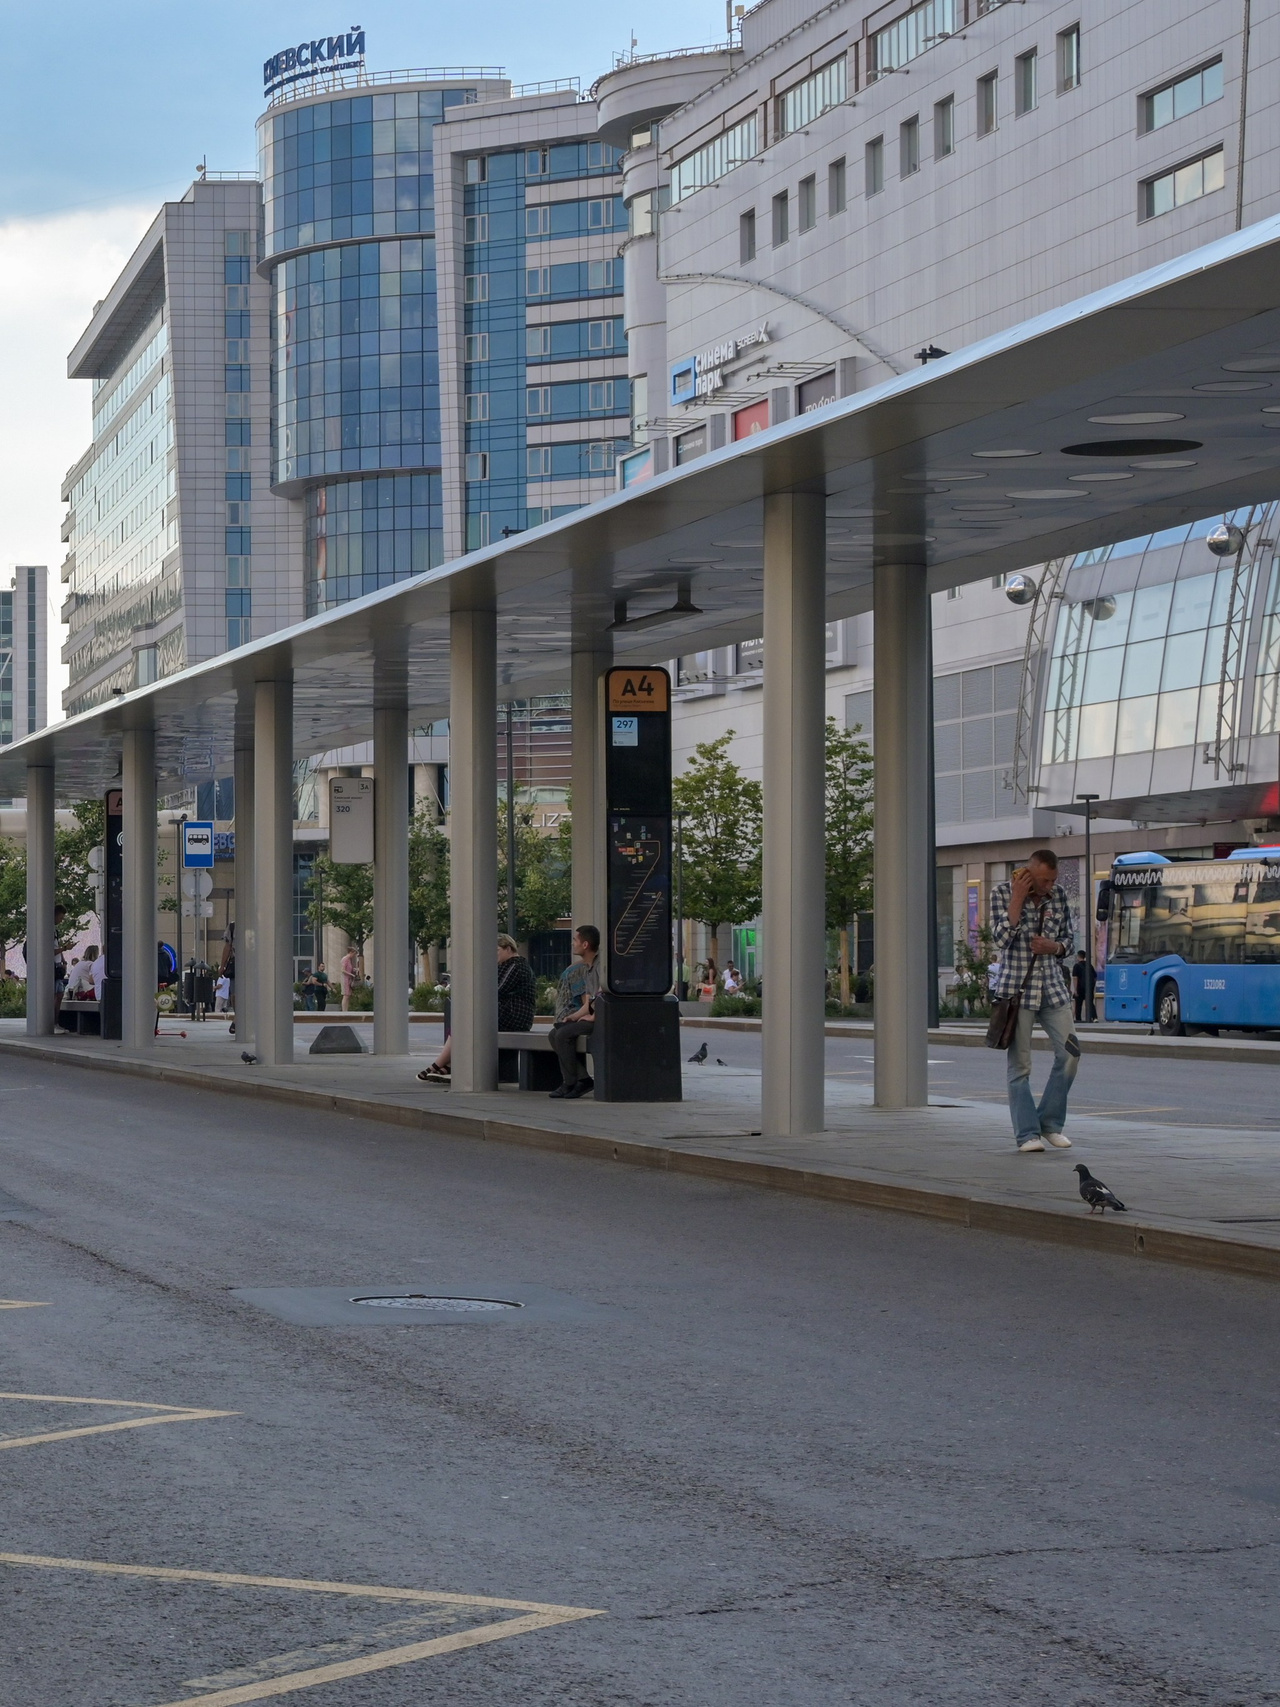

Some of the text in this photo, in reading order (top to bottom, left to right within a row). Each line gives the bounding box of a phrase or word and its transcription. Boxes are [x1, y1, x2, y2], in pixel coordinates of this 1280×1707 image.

[695, 368, 724, 397] парк
[621, 675, 655, 697] А4
[616, 720, 634, 729] 297
[336, 805, 351, 813] 320
